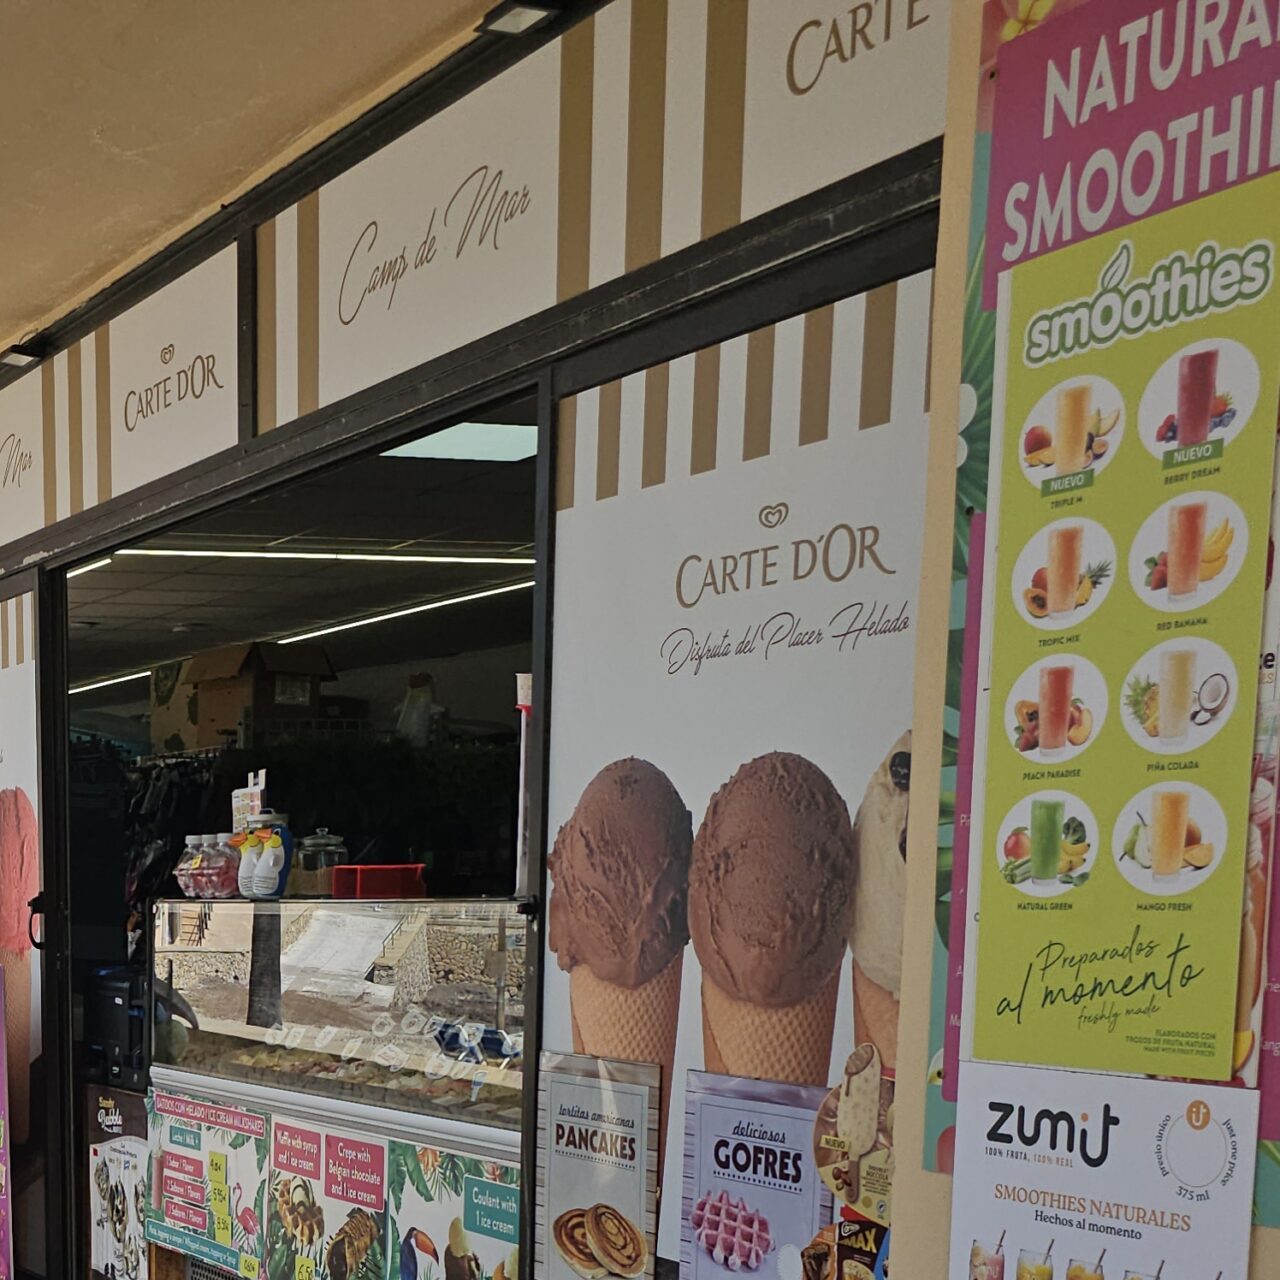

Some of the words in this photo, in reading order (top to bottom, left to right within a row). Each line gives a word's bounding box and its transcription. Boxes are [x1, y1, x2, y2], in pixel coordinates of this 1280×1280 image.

[1043, 0, 1280, 139] NATURA
[338, 221, 409, 325] Camp
[415, 207, 437, 267] de
[444, 165, 532, 258] Mar
[124, 372, 172, 432] CARTE
[1173, 444, 1213, 464] NUEVO
[1050, 474, 1085, 492] NUEVO
[1164, 473, 1189, 485] BERRY
[1191, 467, 1221, 480] DREAM
[1051, 499, 1074, 510] TRIPLE
[675, 545, 780, 609] CARTE
[1156, 622, 1171, 631] RED
[1173, 617, 1208, 630] BANANA
[660, 627, 731, 676] Disfruta
[735, 624, 761, 656] del
[760, 611, 823, 660] Placer
[828, 600, 910, 652] Helado
[1038, 636, 1064, 648] TROPIC
[1065, 634, 1080, 645] MIX
[1023, 771, 1045, 781] PEACH
[1047, 769, 1081, 779] PARADISE
[1146, 762, 1166, 773] PIÑA
[1167, 761, 1199, 771] COLADA
[1017, 902, 1048, 911] NATURAL
[1049, 902, 1073, 911] GREEN
[1136, 902, 1166, 912] MANGO
[1167, 902, 1192, 912] FRESH
[1036, 924, 1160, 982] Preparados
[996, 962, 1033, 1025] al
[1041, 932, 1205, 1009] momento
[1077, 1001, 1122, 1034] freshly
[1124, 993, 1161, 1016] made
[558, 1103, 589, 1120] tortitas
[555, 1122, 636, 1162] PANCAKES
[732, 1119, 786, 1145] deliciosos
[277, 1129, 291, 1146] Waffle
[291, 1135, 303, 1149] with
[303, 1140, 317, 1159] syrup
[337, 1142, 357, 1161] Crepe
[357, 1147, 371, 1162] with
[824, 1137, 846, 1150] NUEVO
[1230, 1140, 1238, 1161] one
[278, 1152, 287, 1163] and
[290, 1156, 298, 1167] ice
[298, 1158, 314, 1171] cream
[714, 1139, 802, 1184] GOFRES
[985, 1146, 1003, 1157] 100%
[1006, 1149, 1030, 1162] FRUTA,
[1033, 1154, 1053, 1164] 100%
[1055, 1156, 1073, 1168] REAL
[329, 1161, 350, 1182] Belgian
[351, 1167, 381, 1185] chocolate
[1220, 1160, 1236, 1187] price
[331, 1183, 343, 1196] and
[347, 1185, 357, 1199] ice
[357, 1190, 377, 1204] cream
[472, 1187, 500, 1210] Coulant
[500, 1197, 517, 1214] with
[1176, 1185, 1195, 1201] 375
[1195, 1189, 1210, 1202] ml
[994, 1183, 1087, 1214] SMOOTHIES
[1089, 1200, 1192, 1232] NATURALES
[480, 1213, 492, 1230] ice
[491, 1217, 514, 1236] cream
[1034, 1209, 1074, 1228] Hechos
[1075, 1218, 1086, 1231] al
[1087, 1222, 1142, 1241] momento
